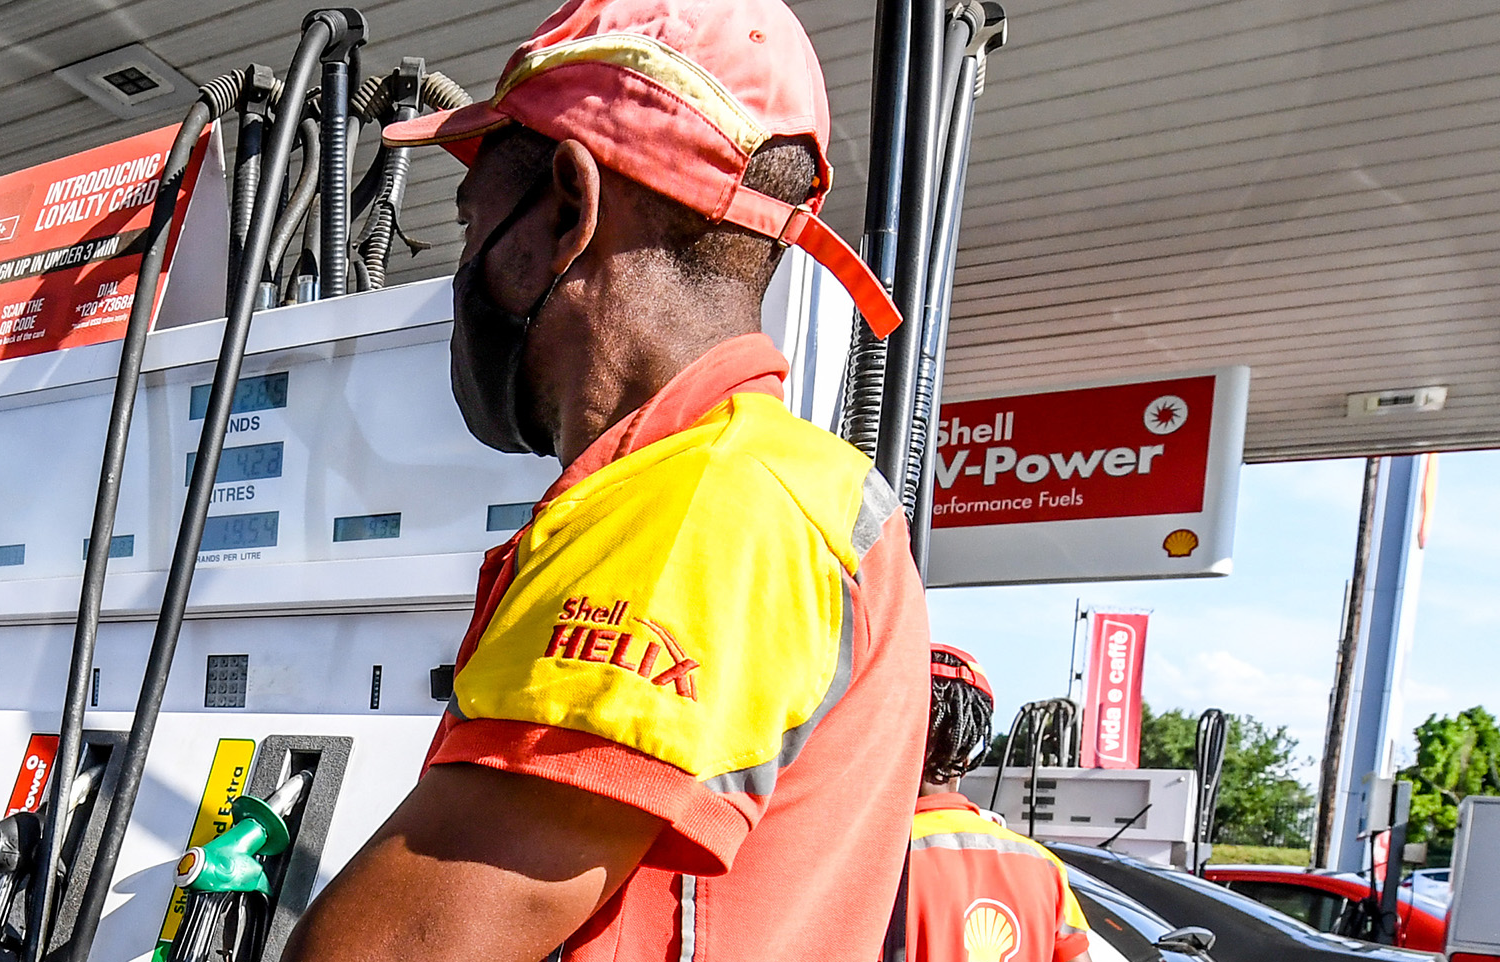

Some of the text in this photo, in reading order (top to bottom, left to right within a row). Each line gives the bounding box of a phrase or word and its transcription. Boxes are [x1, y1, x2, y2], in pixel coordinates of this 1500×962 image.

[43, 153, 161, 206] INTRODUCING
[34, 180, 160, 232] LOYALTY CARD
[13, 257, 30, 277] UP
[30, 254, 45, 272] IN
[43, 245, 84, 270] UNDER
[83, 242, 94, 260] 3
[92, 237, 120, 259] MIN
[96, 281, 119, 298] DIAL
[1, 298, 45, 320] SCAN THE
[12, 315, 38, 333] CODE
[3, 336, 16, 345] back
[16, 333, 23, 342] of
[23, 331, 32, 340] the
[32, 329, 46, 339] card
[225, 415, 261, 434] NDS
[936, 411, 1015, 448] Shell
[936, 443, 1165, 490] V-Power
[932, 487, 1084, 516] erformance Fuels
[222, 553, 238, 562] PER
[240, 552, 261, 561] LITRE
[558, 597, 630, 626] Shell
[544, 617, 700, 702] HELIX
[1101, 630, 1129, 752] vida e caffè
[218, 766, 245, 817] Extra
